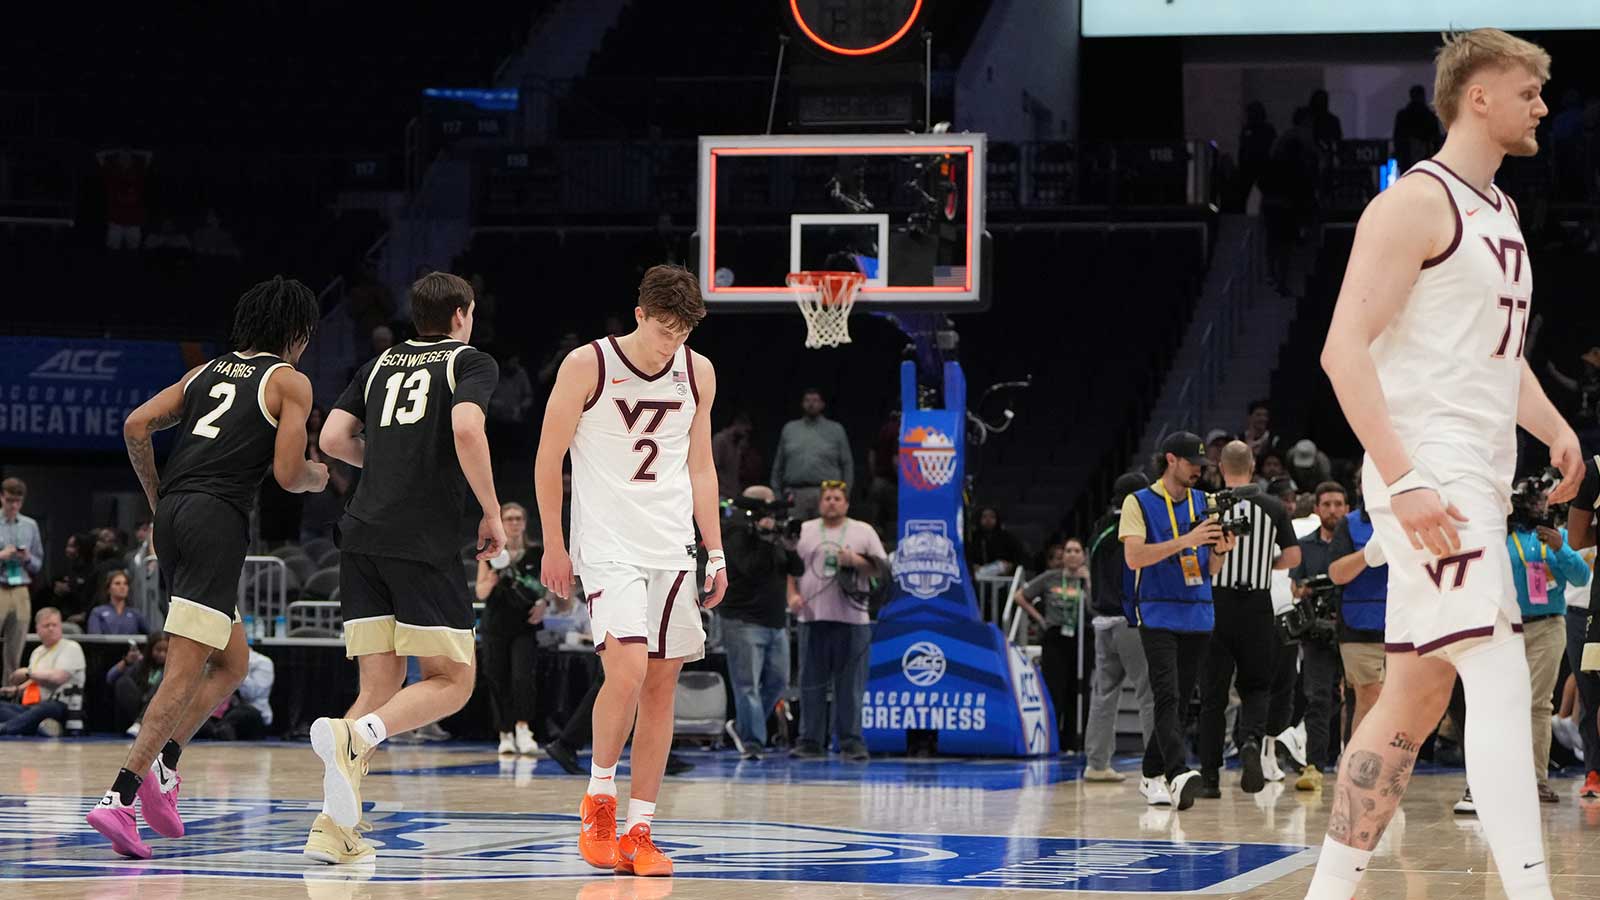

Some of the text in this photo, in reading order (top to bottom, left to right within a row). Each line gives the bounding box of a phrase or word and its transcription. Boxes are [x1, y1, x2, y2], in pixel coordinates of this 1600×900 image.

[1480, 235, 1526, 285] VT
[1490, 294, 1528, 361] 77
[34, 349, 122, 373] ACC
[213, 361, 256, 379] HARRIS
[381, 350, 453, 368] SCHWIEGER
[191, 381, 237, 440] 2
[379, 368, 432, 428] 13
[612, 397, 686, 435] VT
[629, 438, 660, 483] 2
[1421, 547, 1487, 593] VT
[861, 706, 987, 731] GREATNESS
[862, 691, 987, 706] ACCOMPLISH
